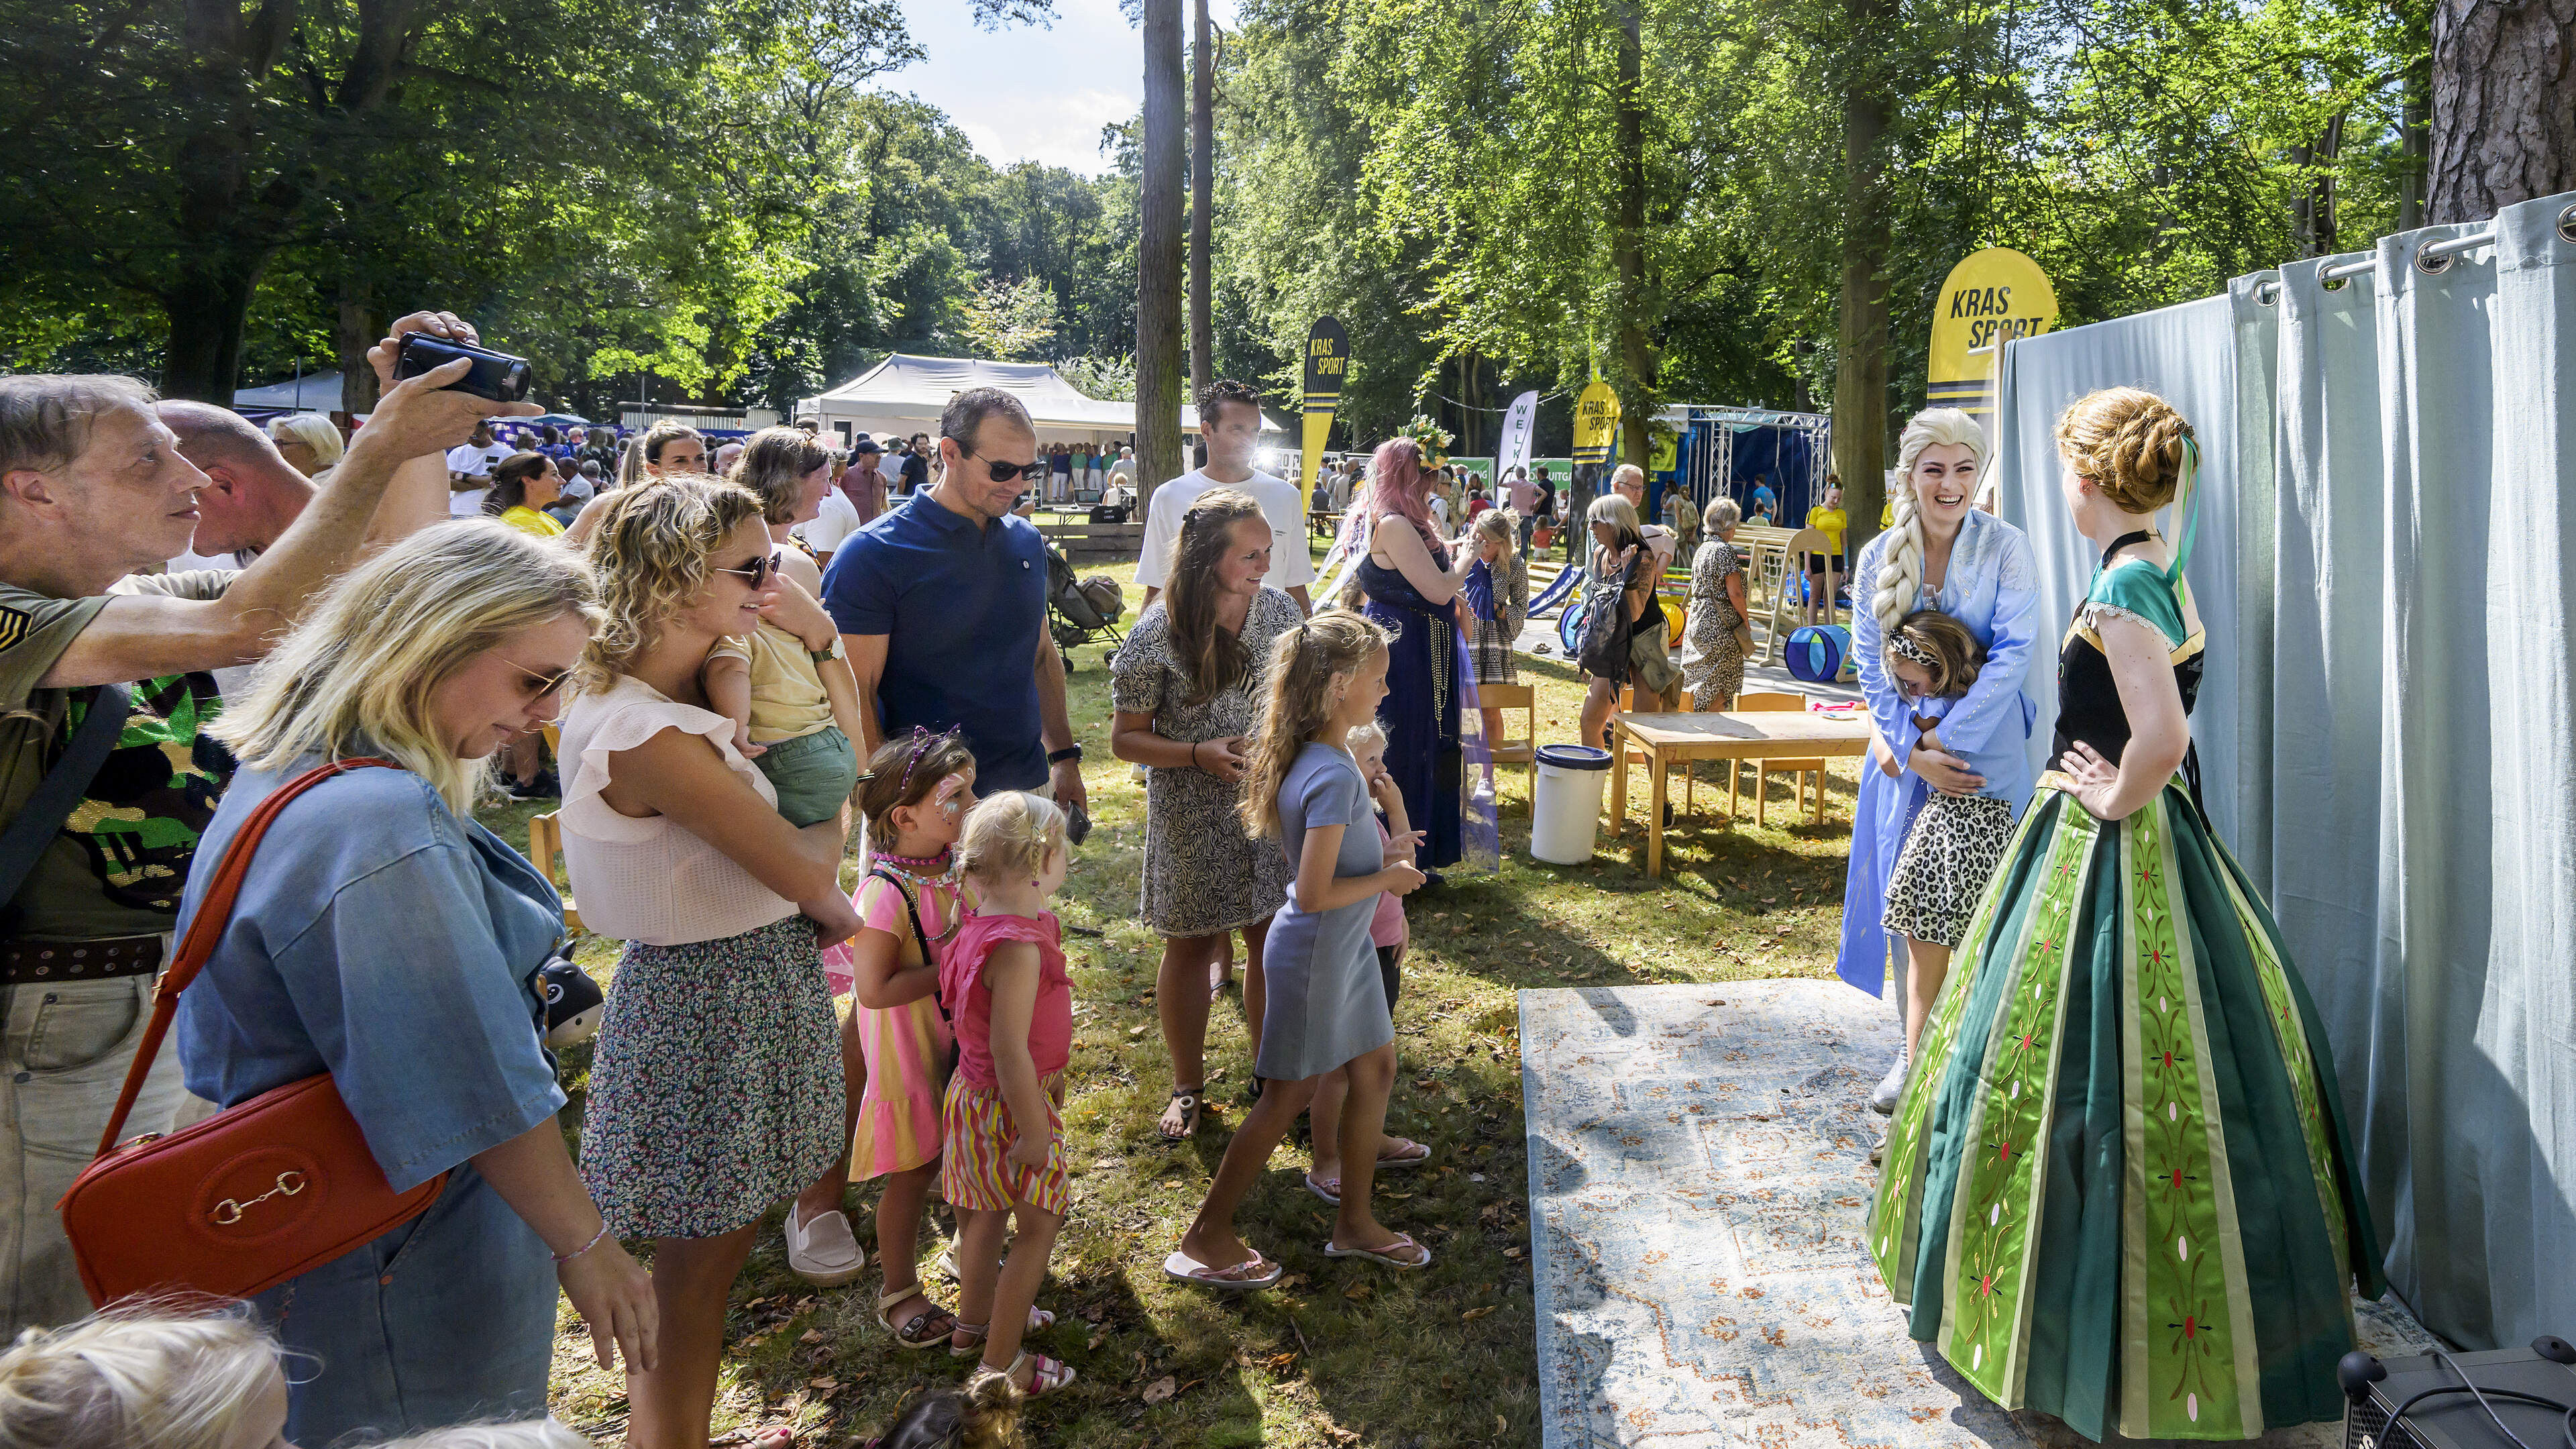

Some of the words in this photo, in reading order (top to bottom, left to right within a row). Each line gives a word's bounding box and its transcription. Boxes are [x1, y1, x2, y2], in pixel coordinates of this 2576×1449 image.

[1950, 286, 2011, 319] KRAS
[1310, 338, 1334, 356] KRAS
[1317, 357, 1345, 375] SPORT
[1582, 400, 1605, 415] KRAS
[1589, 417, 1617, 431] SPORT
